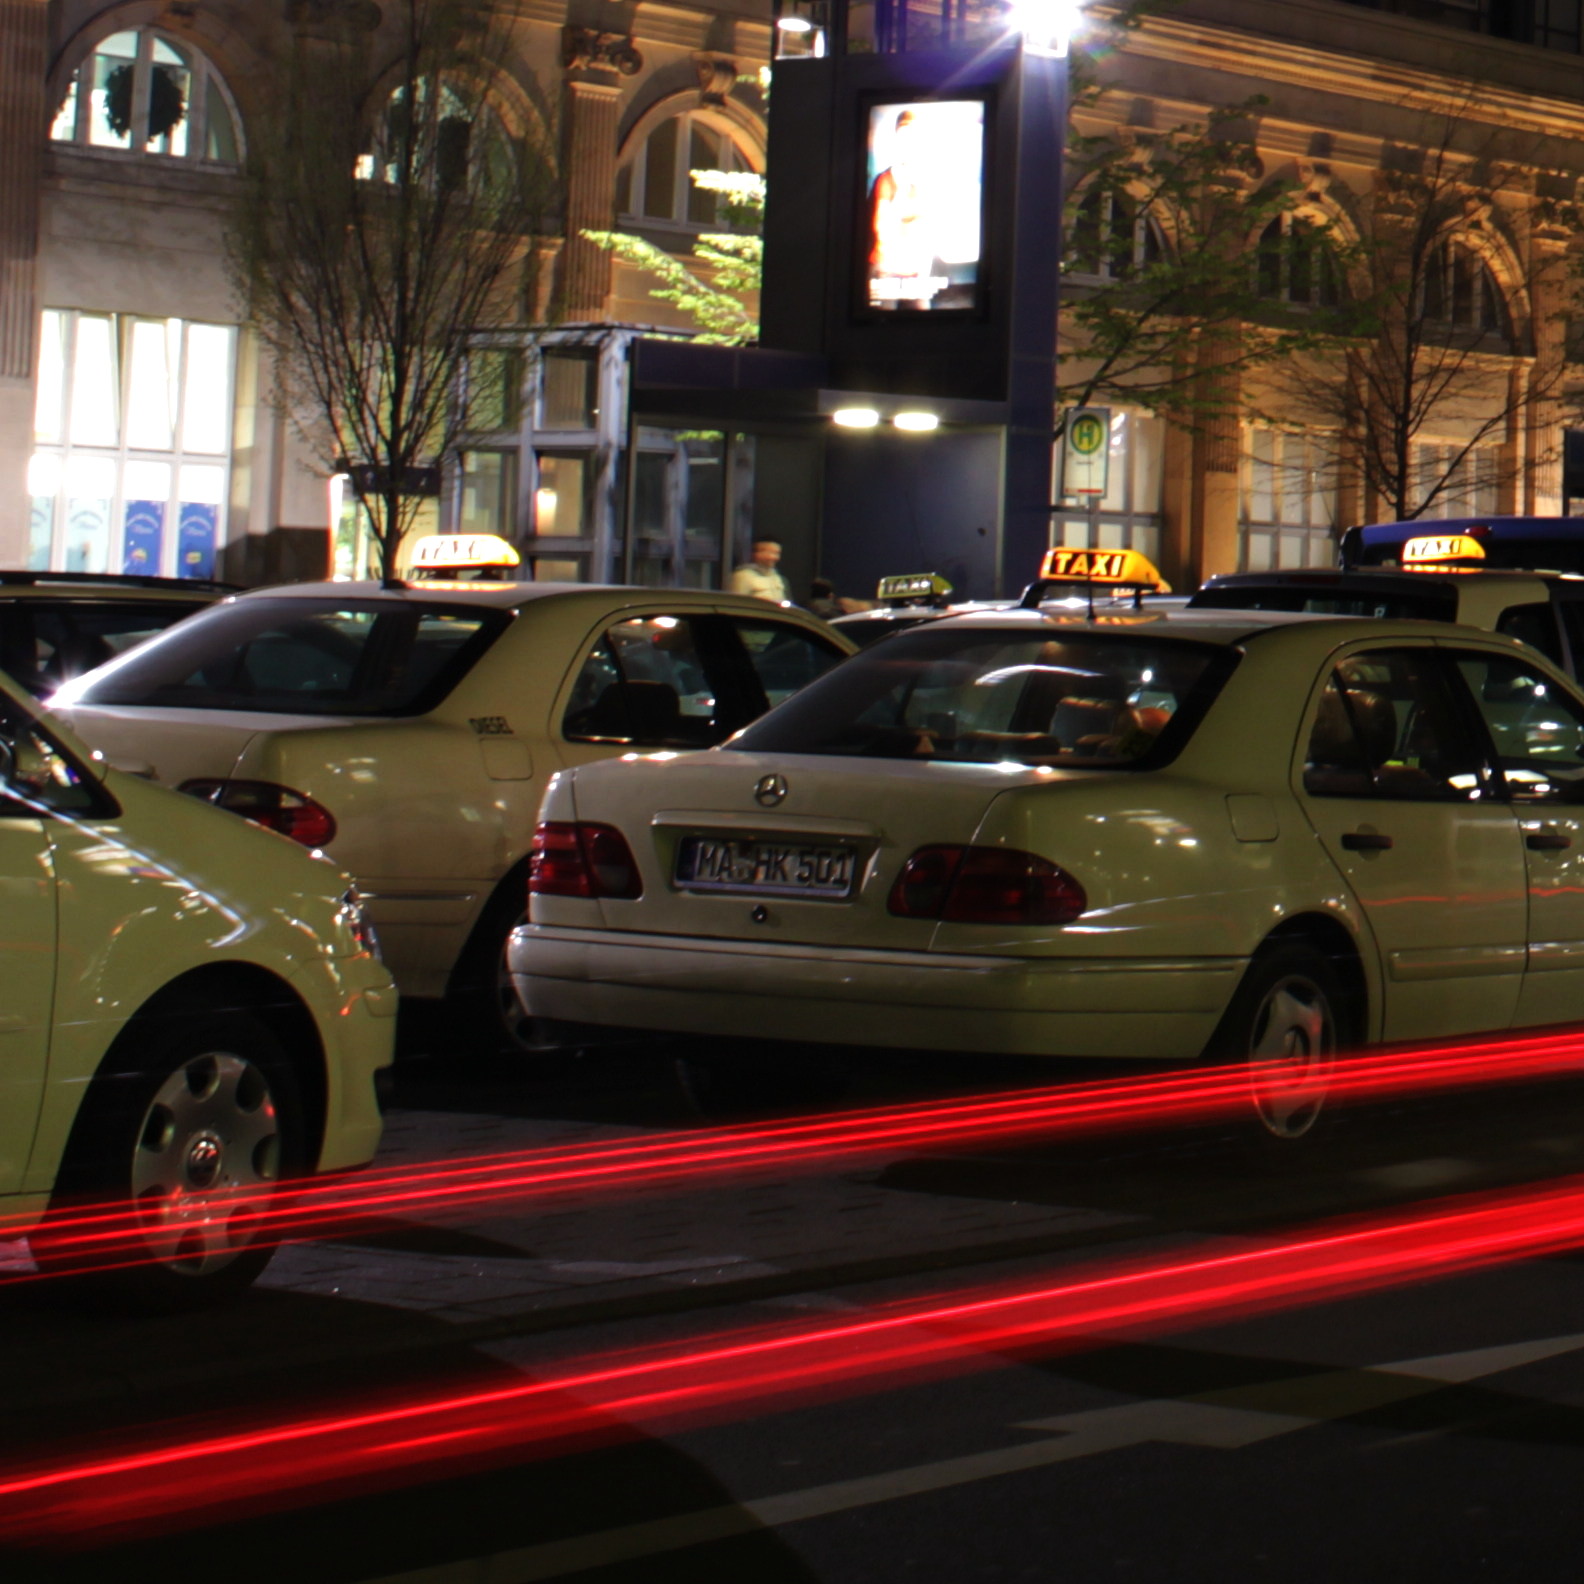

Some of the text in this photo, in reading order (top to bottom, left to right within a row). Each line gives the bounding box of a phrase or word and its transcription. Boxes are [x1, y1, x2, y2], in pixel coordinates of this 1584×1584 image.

[1055, 552, 1122, 577] TAXI
[697, 843, 849, 886] MA HK 501
